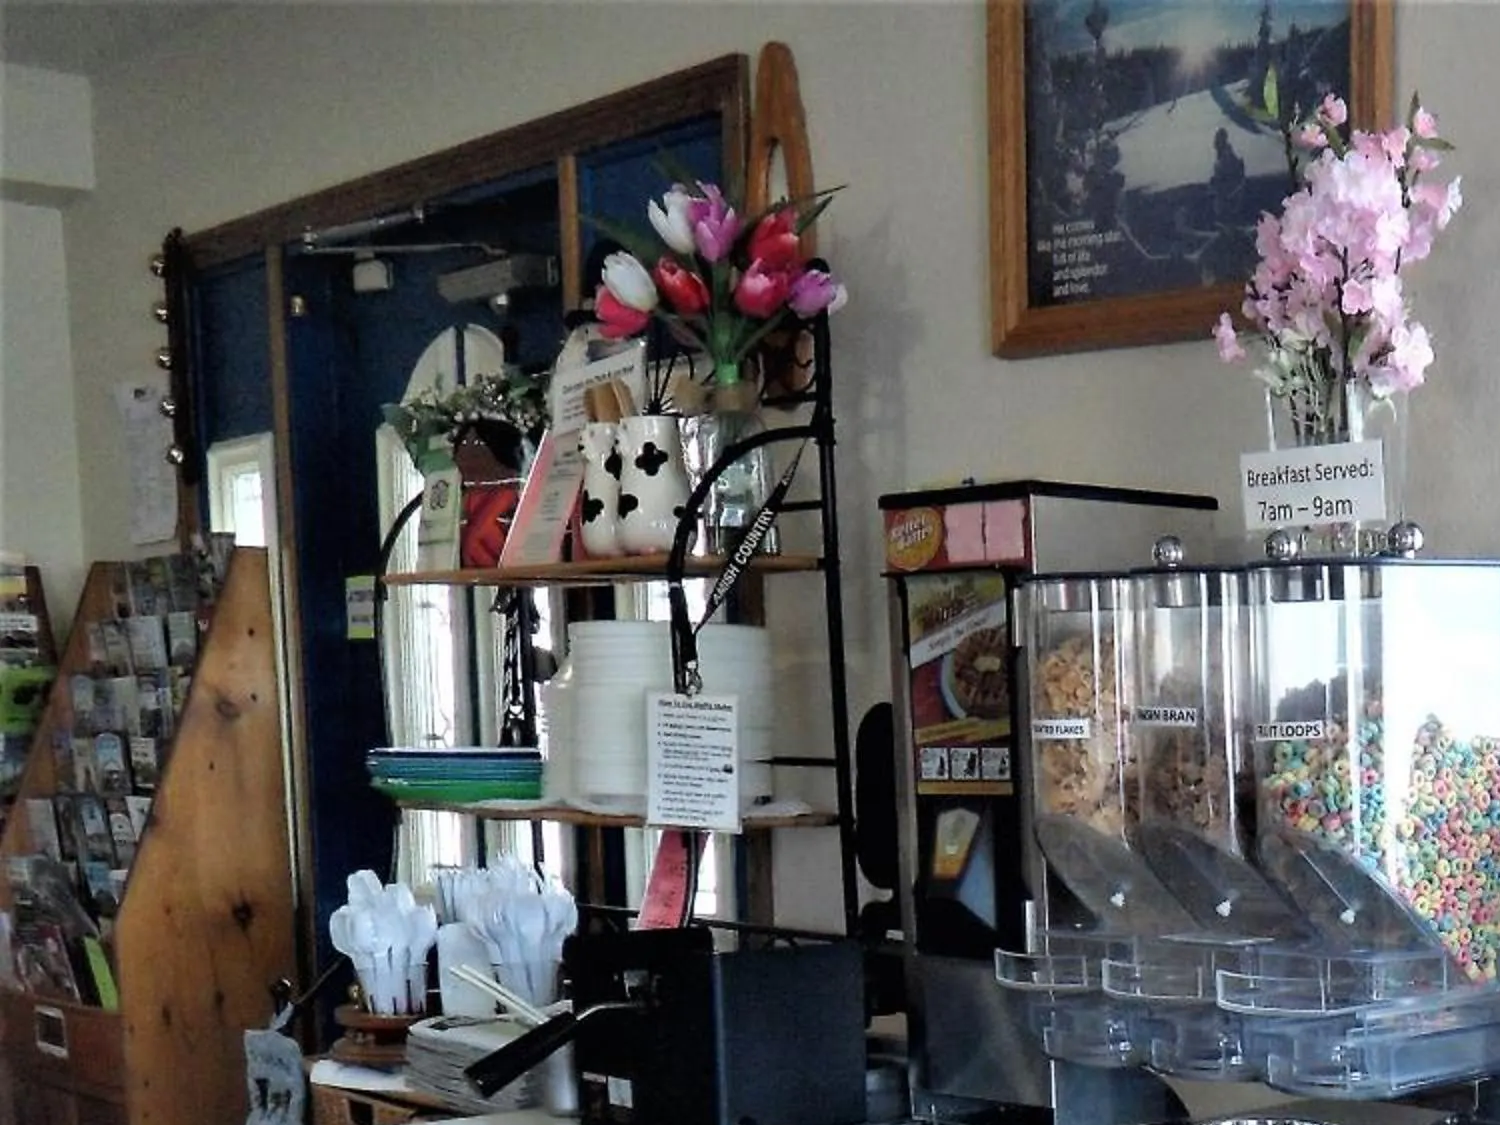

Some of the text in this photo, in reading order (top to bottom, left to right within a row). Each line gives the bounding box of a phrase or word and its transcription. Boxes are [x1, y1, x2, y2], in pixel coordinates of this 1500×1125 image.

[1247, 458, 1375, 488] Breakfast Served:
[1257, 500, 1293, 522] 7am
[1312, 495, 1353, 517] 9am
[733, 506, 775, 566] COUNTRY
[1163, 708, 1196, 722] BRAN
[1055, 724, 1086, 735] FLAKES
[1280, 723, 1322, 737] LOOPS
